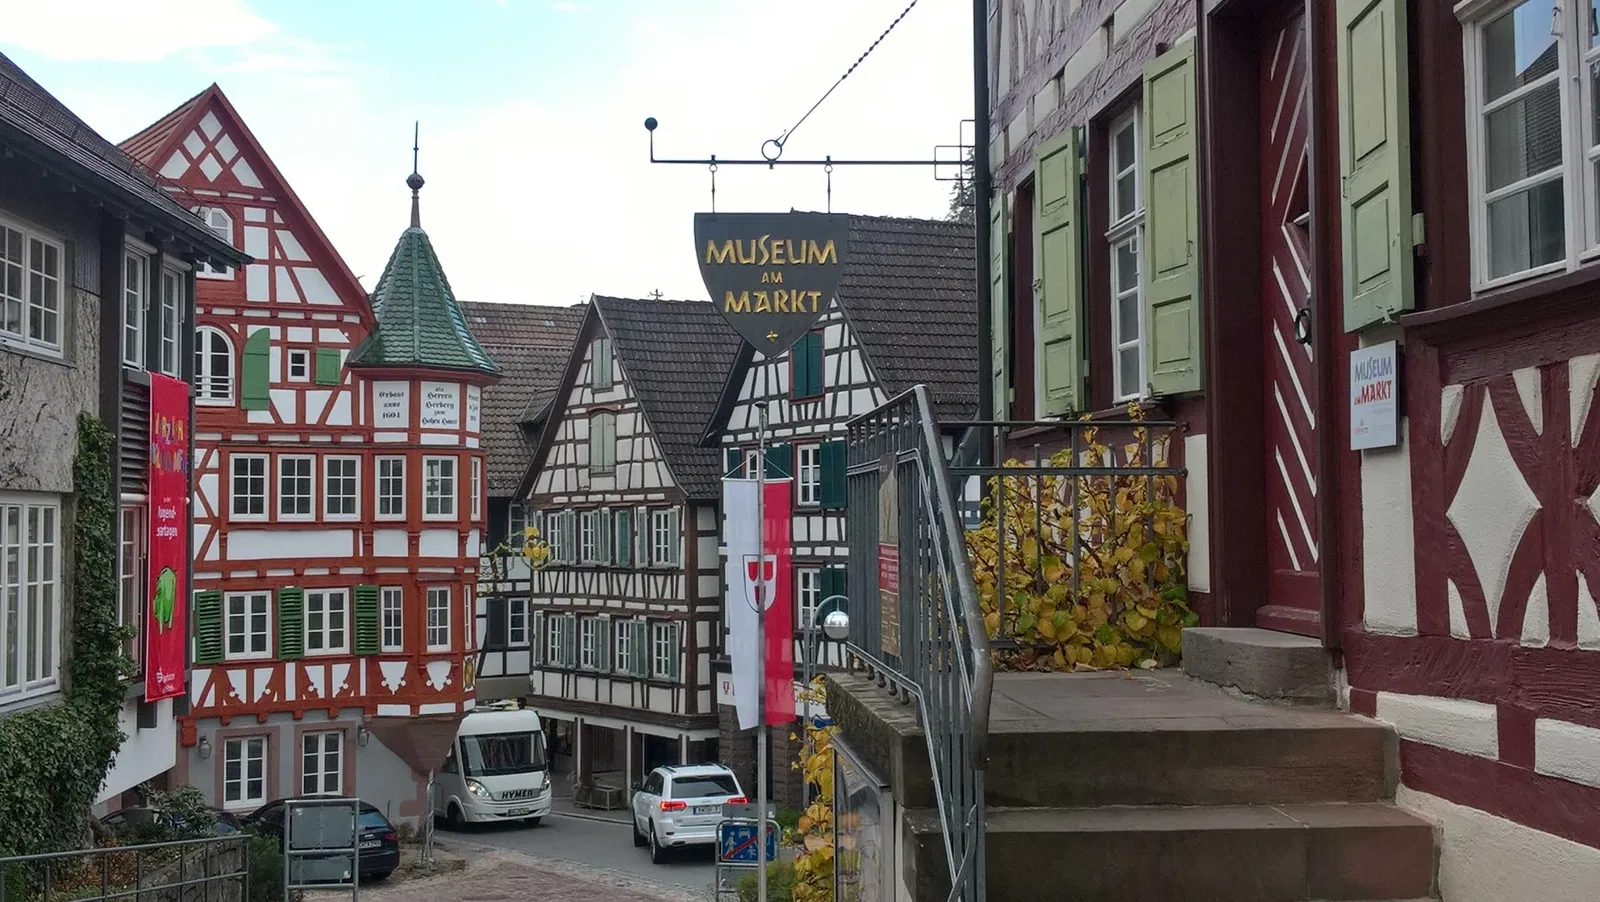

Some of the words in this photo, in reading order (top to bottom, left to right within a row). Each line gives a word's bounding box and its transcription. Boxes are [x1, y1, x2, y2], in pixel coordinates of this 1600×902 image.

[706, 234, 838, 266] MUSEUM
[761, 271, 783, 284] AM
[724, 289, 822, 313] MARKT
[1354, 356, 1393, 382] MUSEUM
[428, 392, 453, 400] Herren
[1361, 380, 1392, 404] MARKT
[426, 401, 454, 409] Herberg
[502, 789, 533, 799] HYMER
